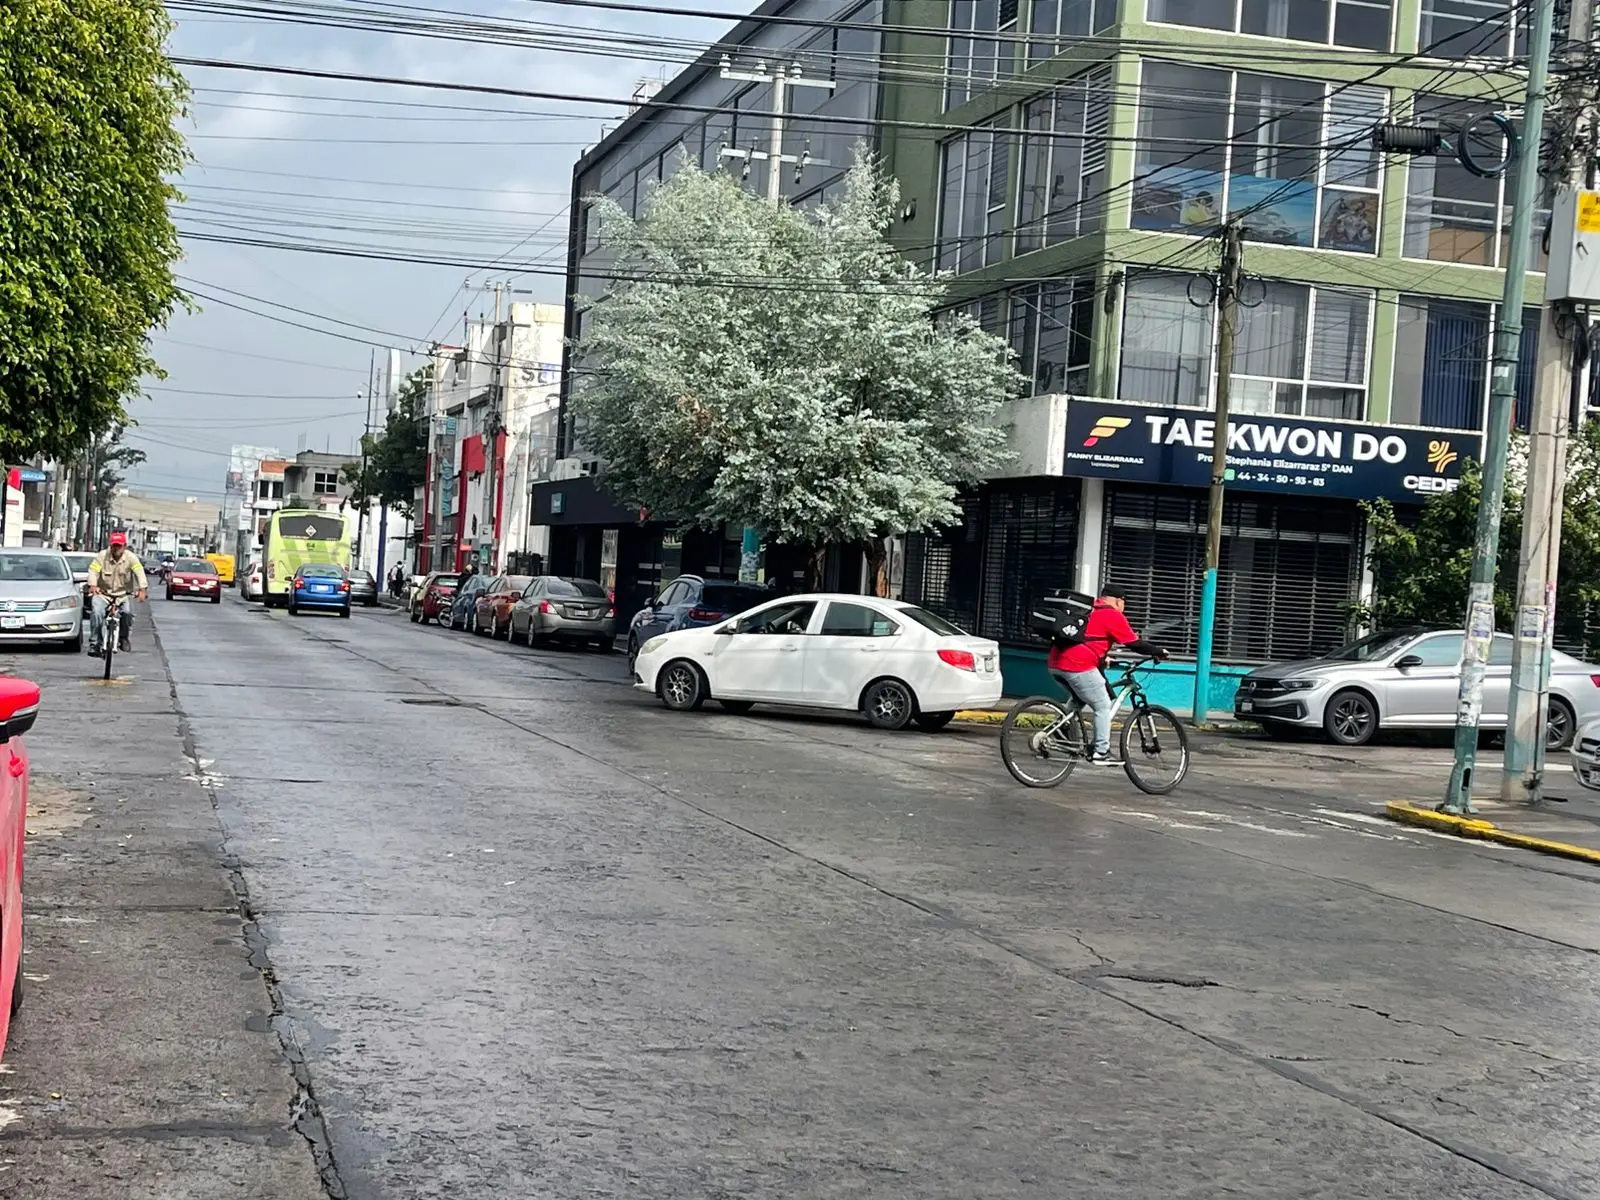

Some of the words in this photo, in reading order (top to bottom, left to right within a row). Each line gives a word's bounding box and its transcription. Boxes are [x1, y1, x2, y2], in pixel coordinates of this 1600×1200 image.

[1067, 452, 1094, 460] FANNY
[1353, 433, 1407, 464] DO
[1197, 453, 1214, 463] Pro
[1225, 455, 1272, 468] Stephania
[1273, 459, 1320, 471] Elizarraraz
[1332, 466, 1353, 474] DAN
[1237, 471, 1250, 481] 44
[1257, 473, 1269, 482] 34
[1276, 474, 1288, 483] 50
